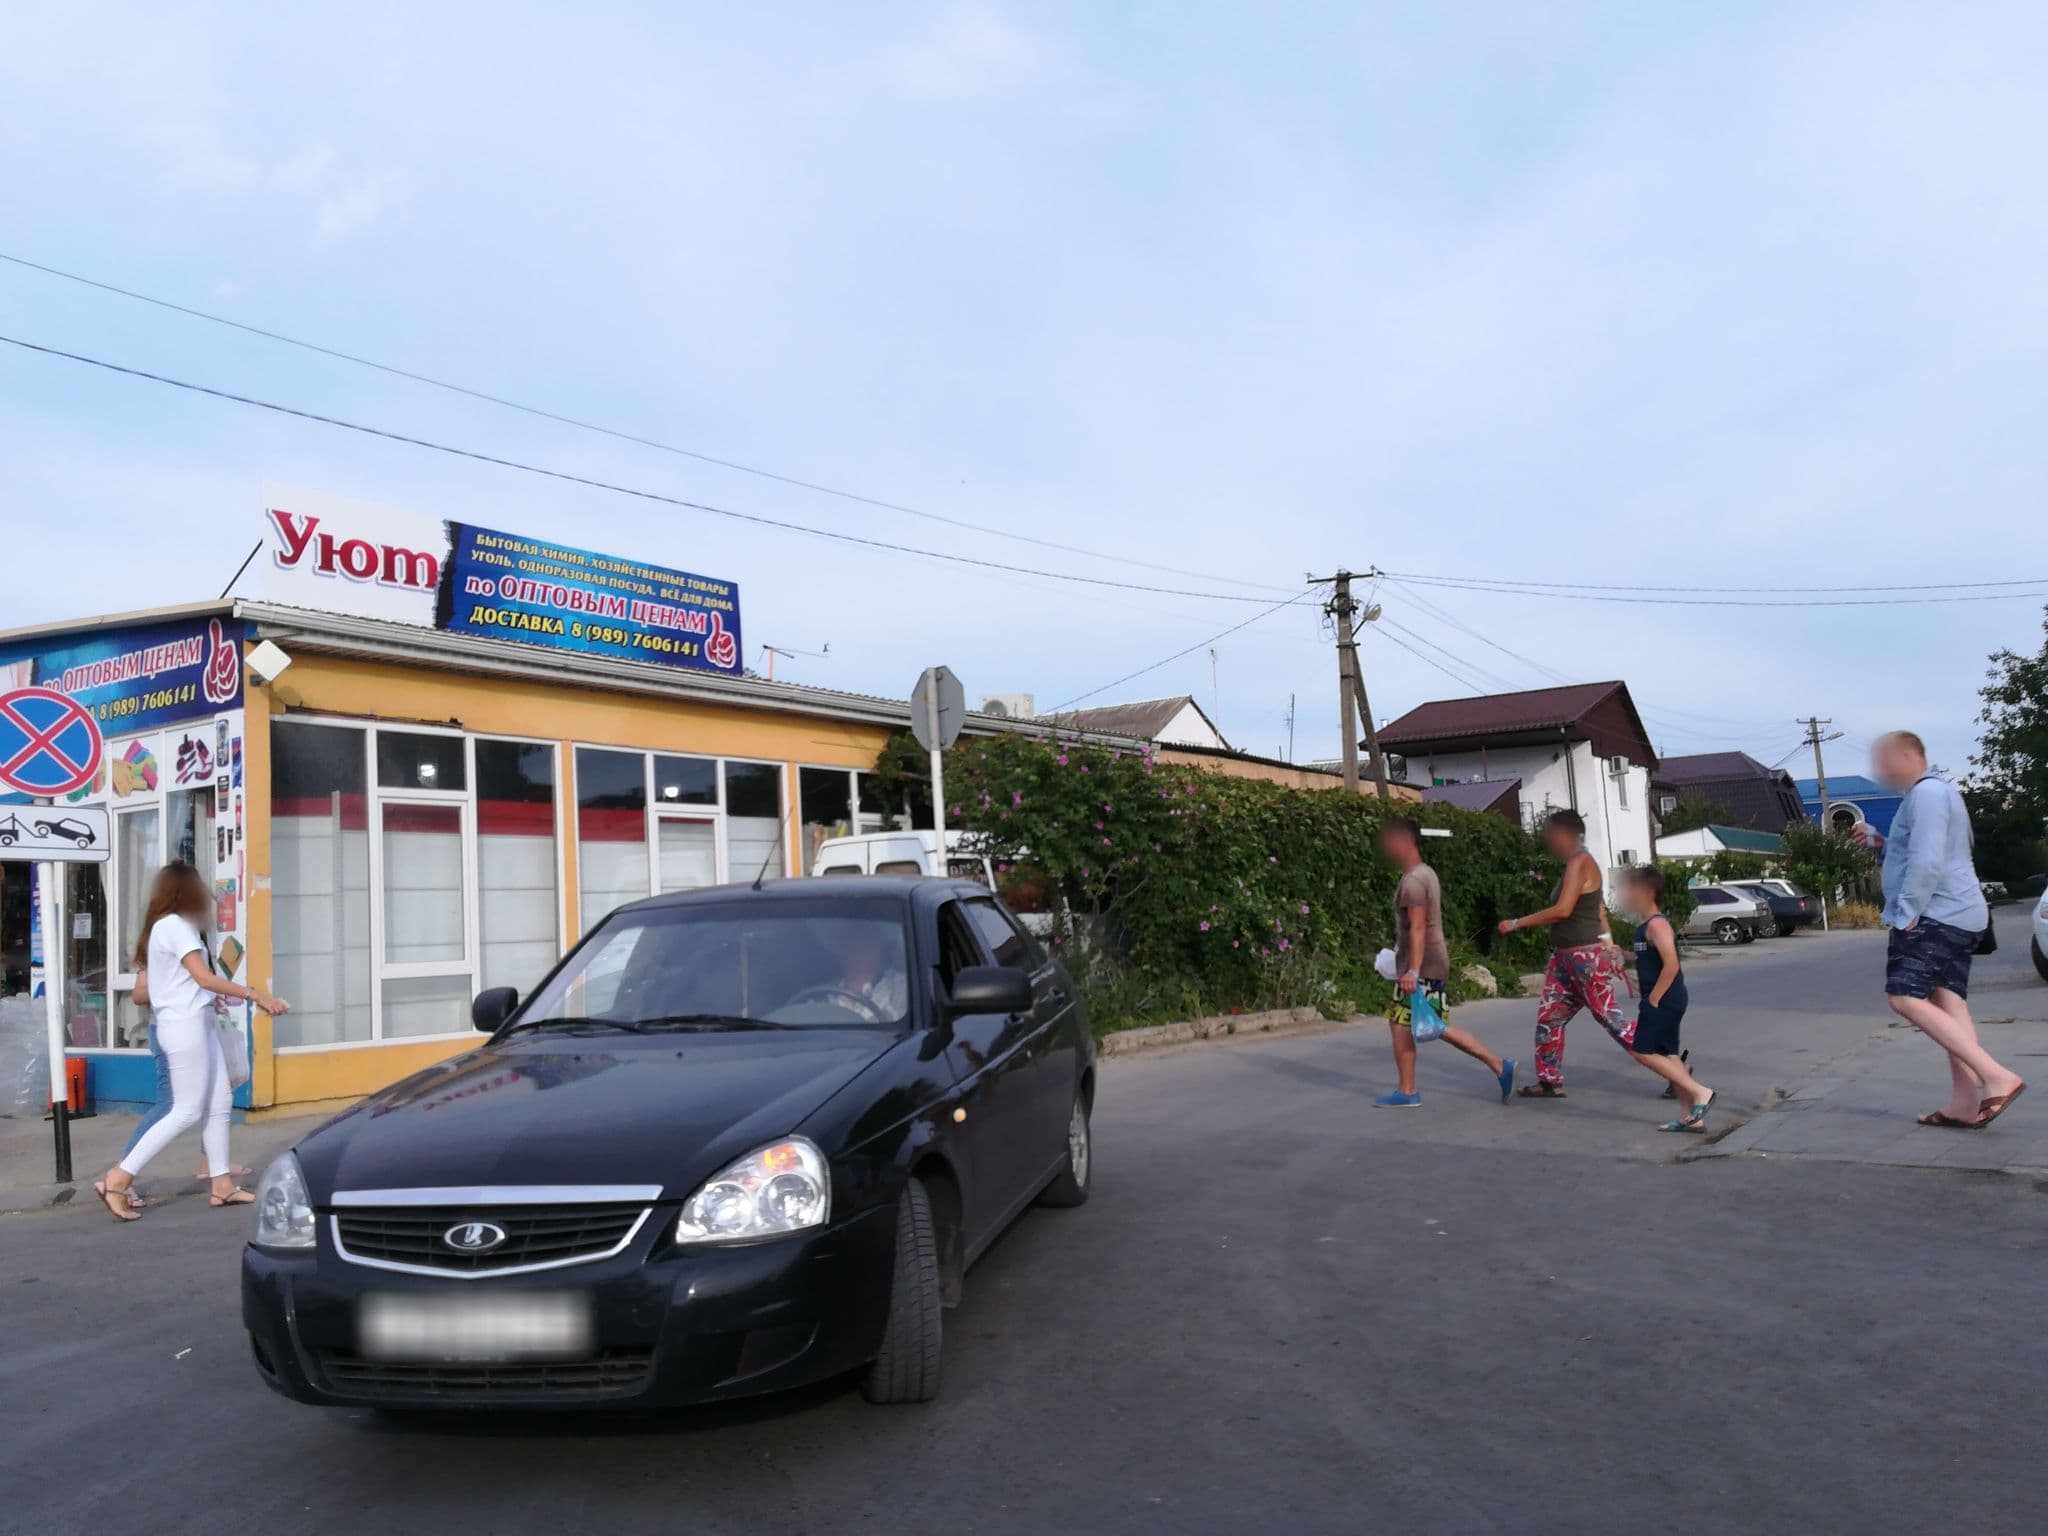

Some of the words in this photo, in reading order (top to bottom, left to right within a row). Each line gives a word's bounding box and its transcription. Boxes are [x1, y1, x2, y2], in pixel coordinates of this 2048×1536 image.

[268, 508, 438, 590] Уют
[476, 534, 538, 555] БЫТОВАЯ
[591, 558, 685, 583] ХОЗЯЙСТВЕННЫЕ
[687, 579, 728, 595] ТОВАРЫ
[466, 577, 495, 596] по
[499, 575, 627, 619] ОПТОВЫМ
[630, 600, 707, 634] ЦЕНАМ
[518, 560, 606, 585] ОДНОРАЗОВАЯ
[661, 588, 680, 601] ВСЁ
[680, 593, 701, 605] ДЛЯ
[702, 597, 733, 611] ДОМА
[469, 606, 565, 635] ДОСТАВКА
[571, 622, 582, 637] 8
[586, 625, 628, 646] (989)
[632, 633, 698, 656] 7606141
[63, 651, 142, 693] ОПТОВЫМ
[142, 636, 203, 679] ЦЕНАМ
[99, 703, 107, 720] 8
[109, 696, 140, 720] (989)
[142, 684, 196, 710] 7606141
